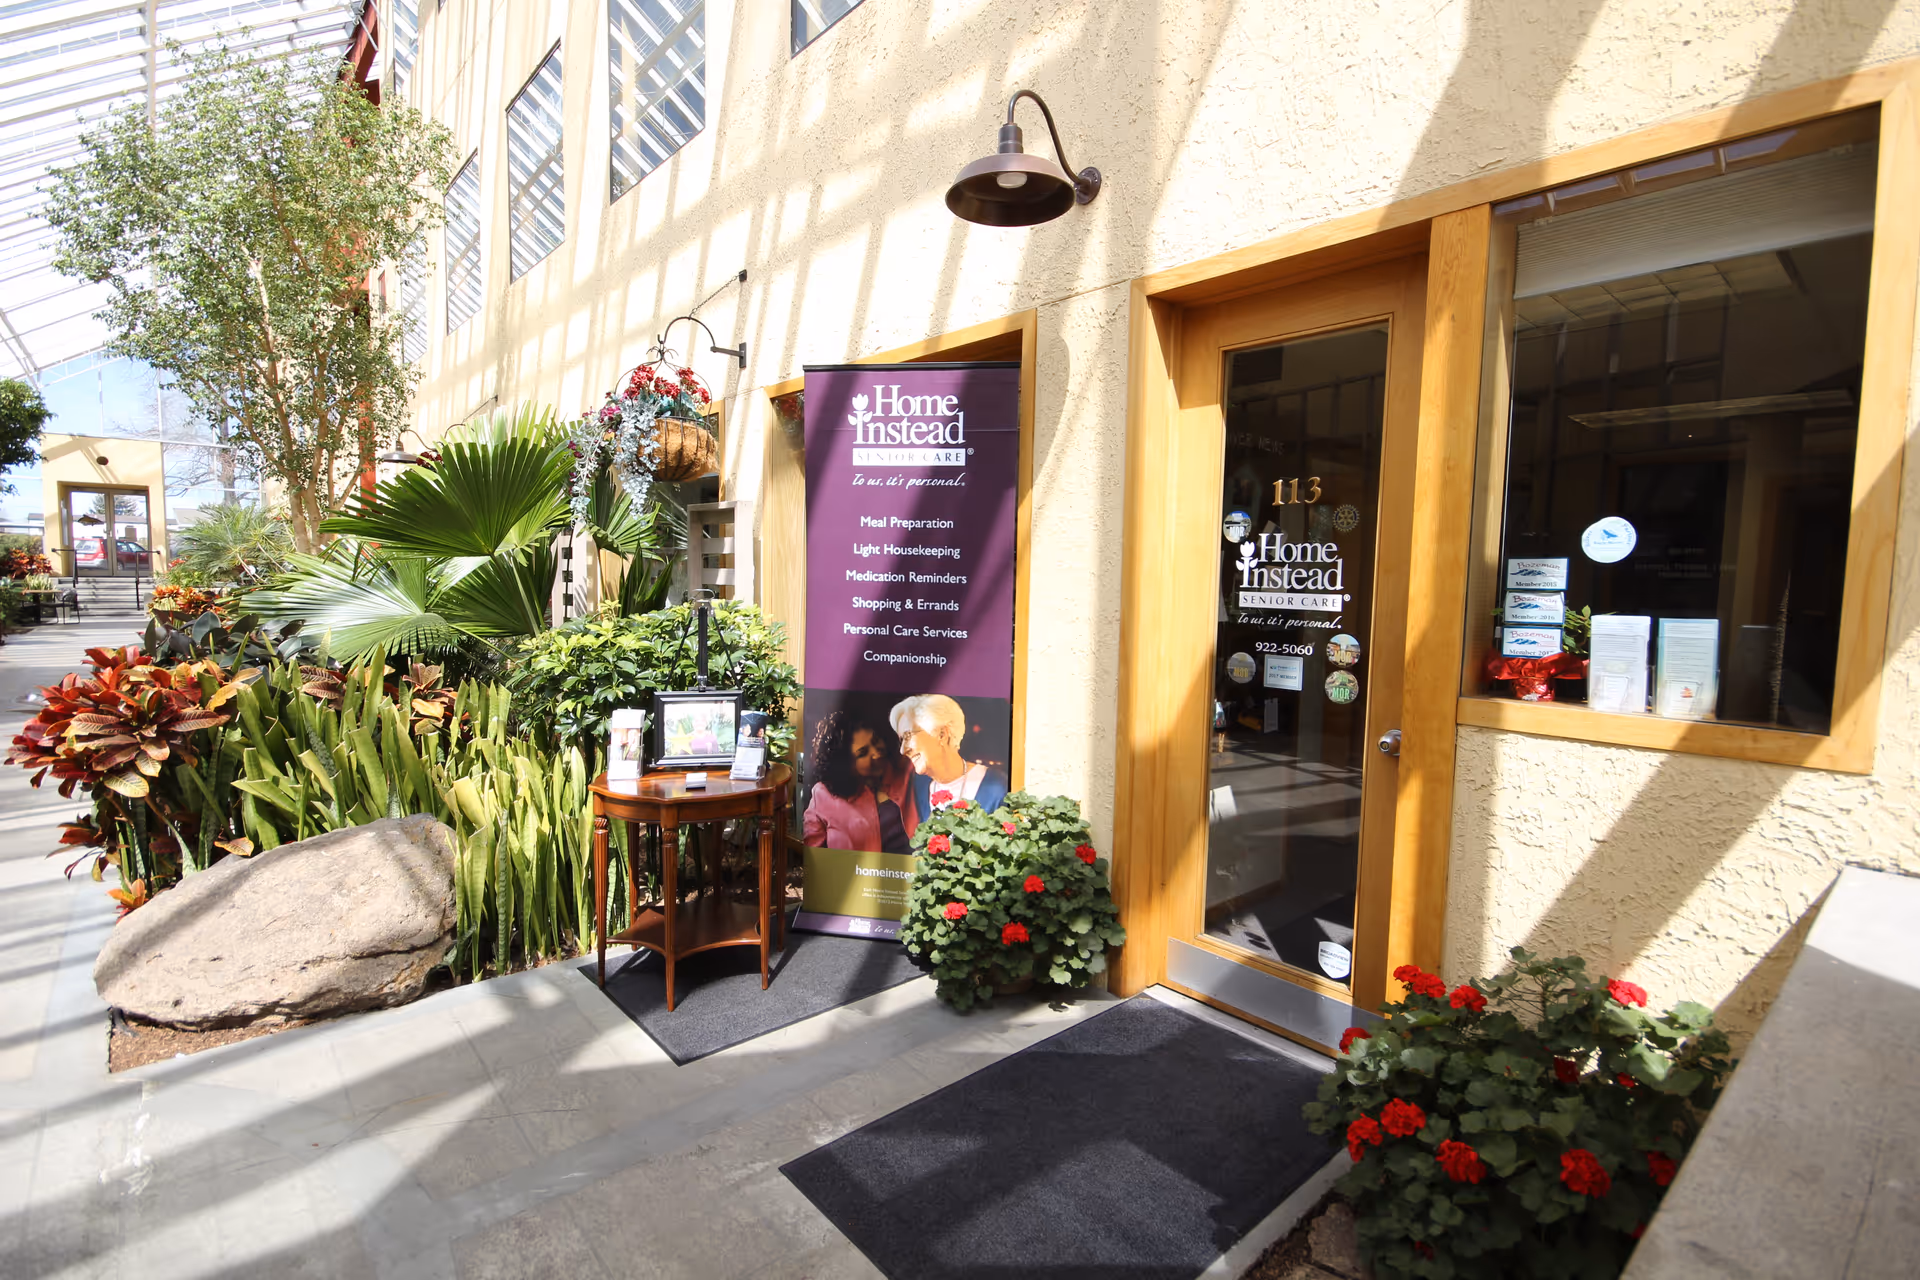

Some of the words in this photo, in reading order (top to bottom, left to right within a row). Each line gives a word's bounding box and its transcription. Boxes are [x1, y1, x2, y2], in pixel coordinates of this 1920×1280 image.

[872, 384, 959, 417] Home
[852, 411, 966, 445] Instead
[857, 451, 914, 463] SENIOR
[922, 452, 963, 463] CARE
[852, 473, 864, 486] To
[866, 479, 884, 487] us,
[886, 474, 905, 487] it's
[905, 472, 966, 490] personal.
[1272, 476, 1322, 506] 113
[860, 515, 887, 528] Meal
[890, 516, 954, 531] Preparation
[853, 543, 880, 558] Light
[883, 543, 961, 559] Housekeeping
[1258, 532, 1339, 563] Home
[1517, 561, 1561, 570] Bozeman
[845, 569, 905, 582] Medication
[909, 571, 967, 584] Reminders
[1239, 558, 1344, 591] Instead
[852, 596, 902, 612] Shopping
[904, 598, 914, 610] &
[917, 598, 960, 611] Errands
[1243, 595, 1294, 606] SENIOR
[1301, 596, 1338, 608] CARE
[1513, 595, 1557, 604] Bozeman
[1238, 612, 1248, 624] To
[1267, 614, 1284, 626] it's
[1285, 616, 1343, 629] personal.
[843, 622, 890, 635] Personal
[893, 624, 920, 637] Care
[923, 626, 968, 639] Services
[1511, 630, 1555, 640] Bozeman
[1255, 641, 1313, 656] 922-5060
[1334, 649, 1352, 664] MOR
[863, 650, 947, 667] Companionship
[1332, 687, 1350, 700] MOR
